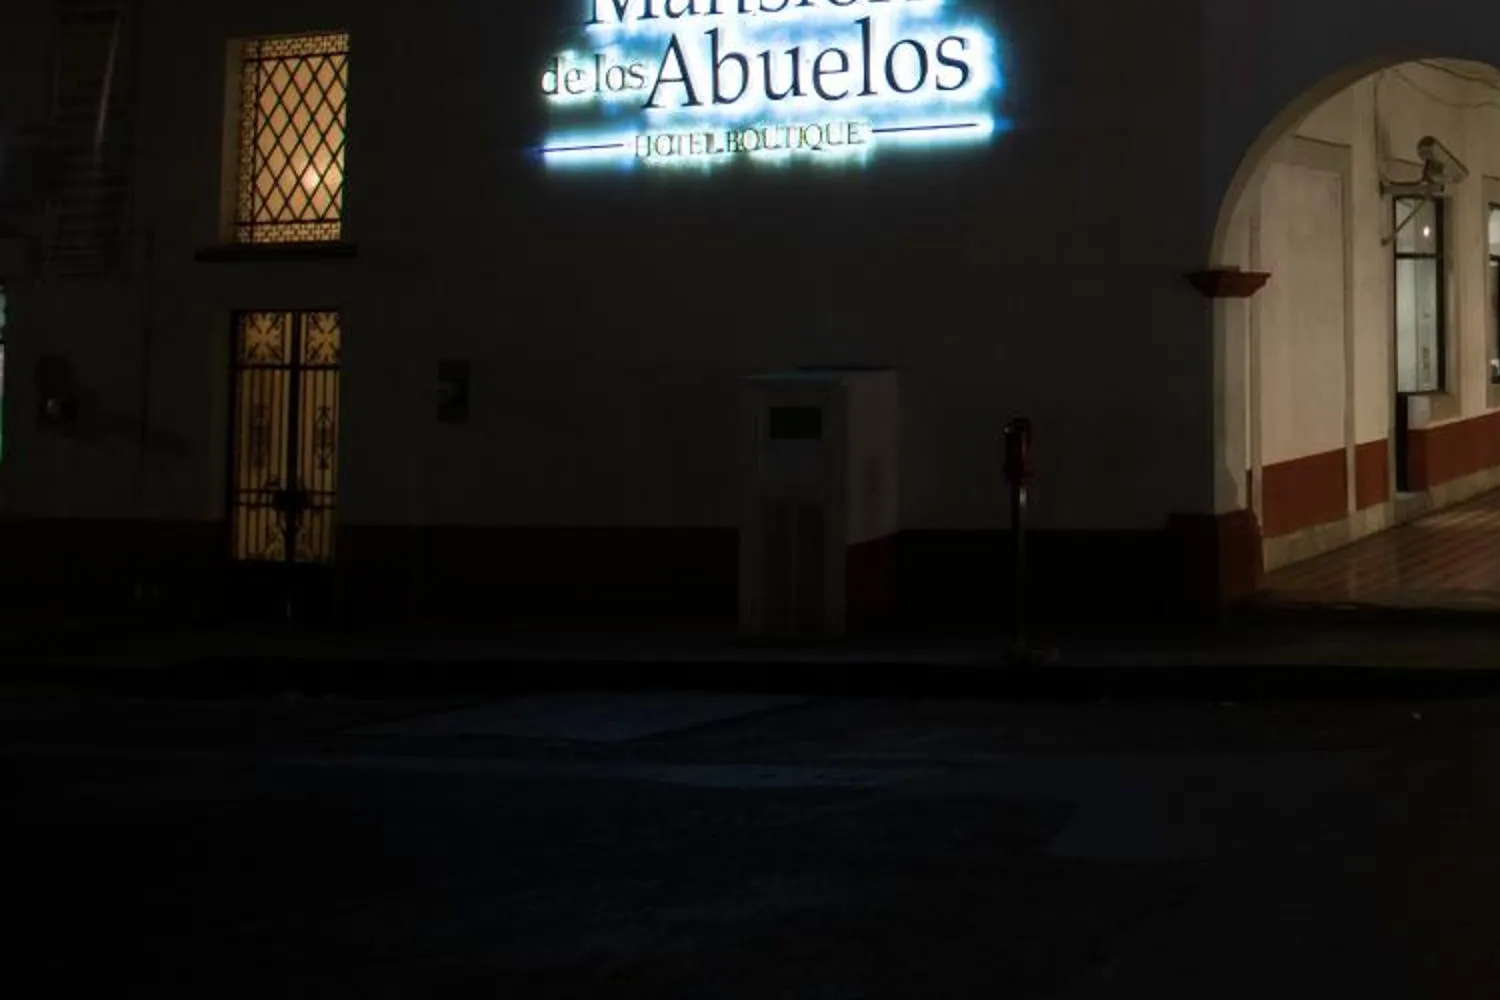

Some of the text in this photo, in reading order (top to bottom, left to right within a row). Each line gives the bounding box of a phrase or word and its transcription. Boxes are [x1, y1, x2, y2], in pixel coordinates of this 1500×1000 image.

[540, 16, 973, 110] de los Abuelos
[634, 121, 868, 158] HOTEL BOUTIQUE
